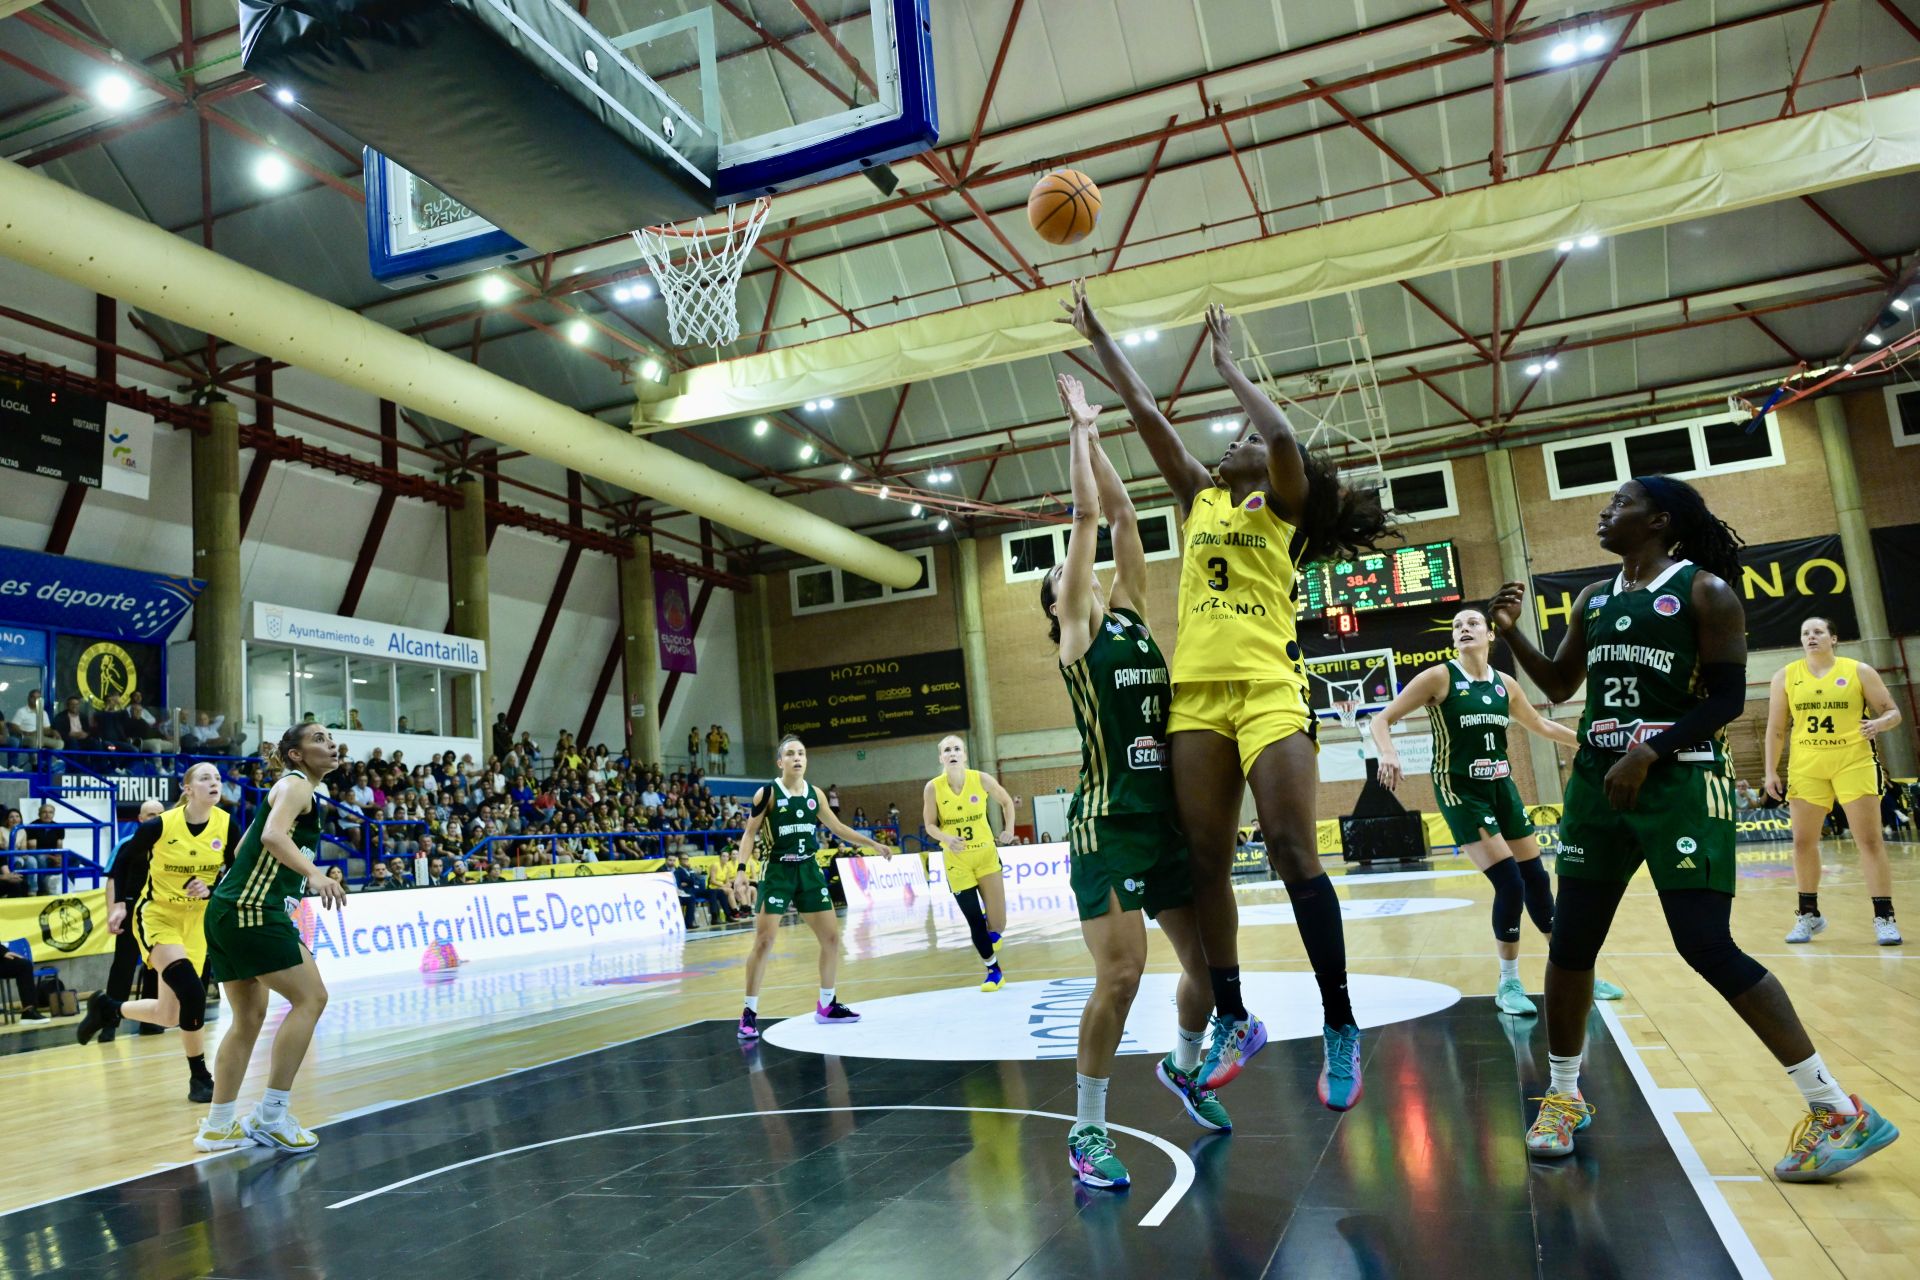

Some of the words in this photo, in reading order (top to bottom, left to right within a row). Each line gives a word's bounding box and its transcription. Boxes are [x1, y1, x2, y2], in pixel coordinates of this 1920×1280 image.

[0, 398, 31, 415] LOCAL
[72, 418, 100, 433] VISITANTE
[1224, 532, 1267, 549] JAIRIS
[1207, 556, 1229, 592] 3
[1346, 572, 1378, 588] 38.4
[0, 579, 31, 596] es
[36, 580, 137, 612] deporte
[288, 623, 361, 647] Ayuntamiento
[363, 635, 375, 647] de
[388, 632, 479, 665] Alcantarilla
[831, 662, 900, 682] HOZONO
[930, 682, 961, 692] SOTECA
[1604, 677, 1641, 708] 23
[1141, 694, 1161, 724] 44
[1823, 701, 1849, 710] JAIRIS
[1807, 715, 1835, 734] 34
[956, 826, 974, 841] 13
[798, 838, 806, 854] 5
[312, 891, 647, 960] AlcantarillaEsDeporte
